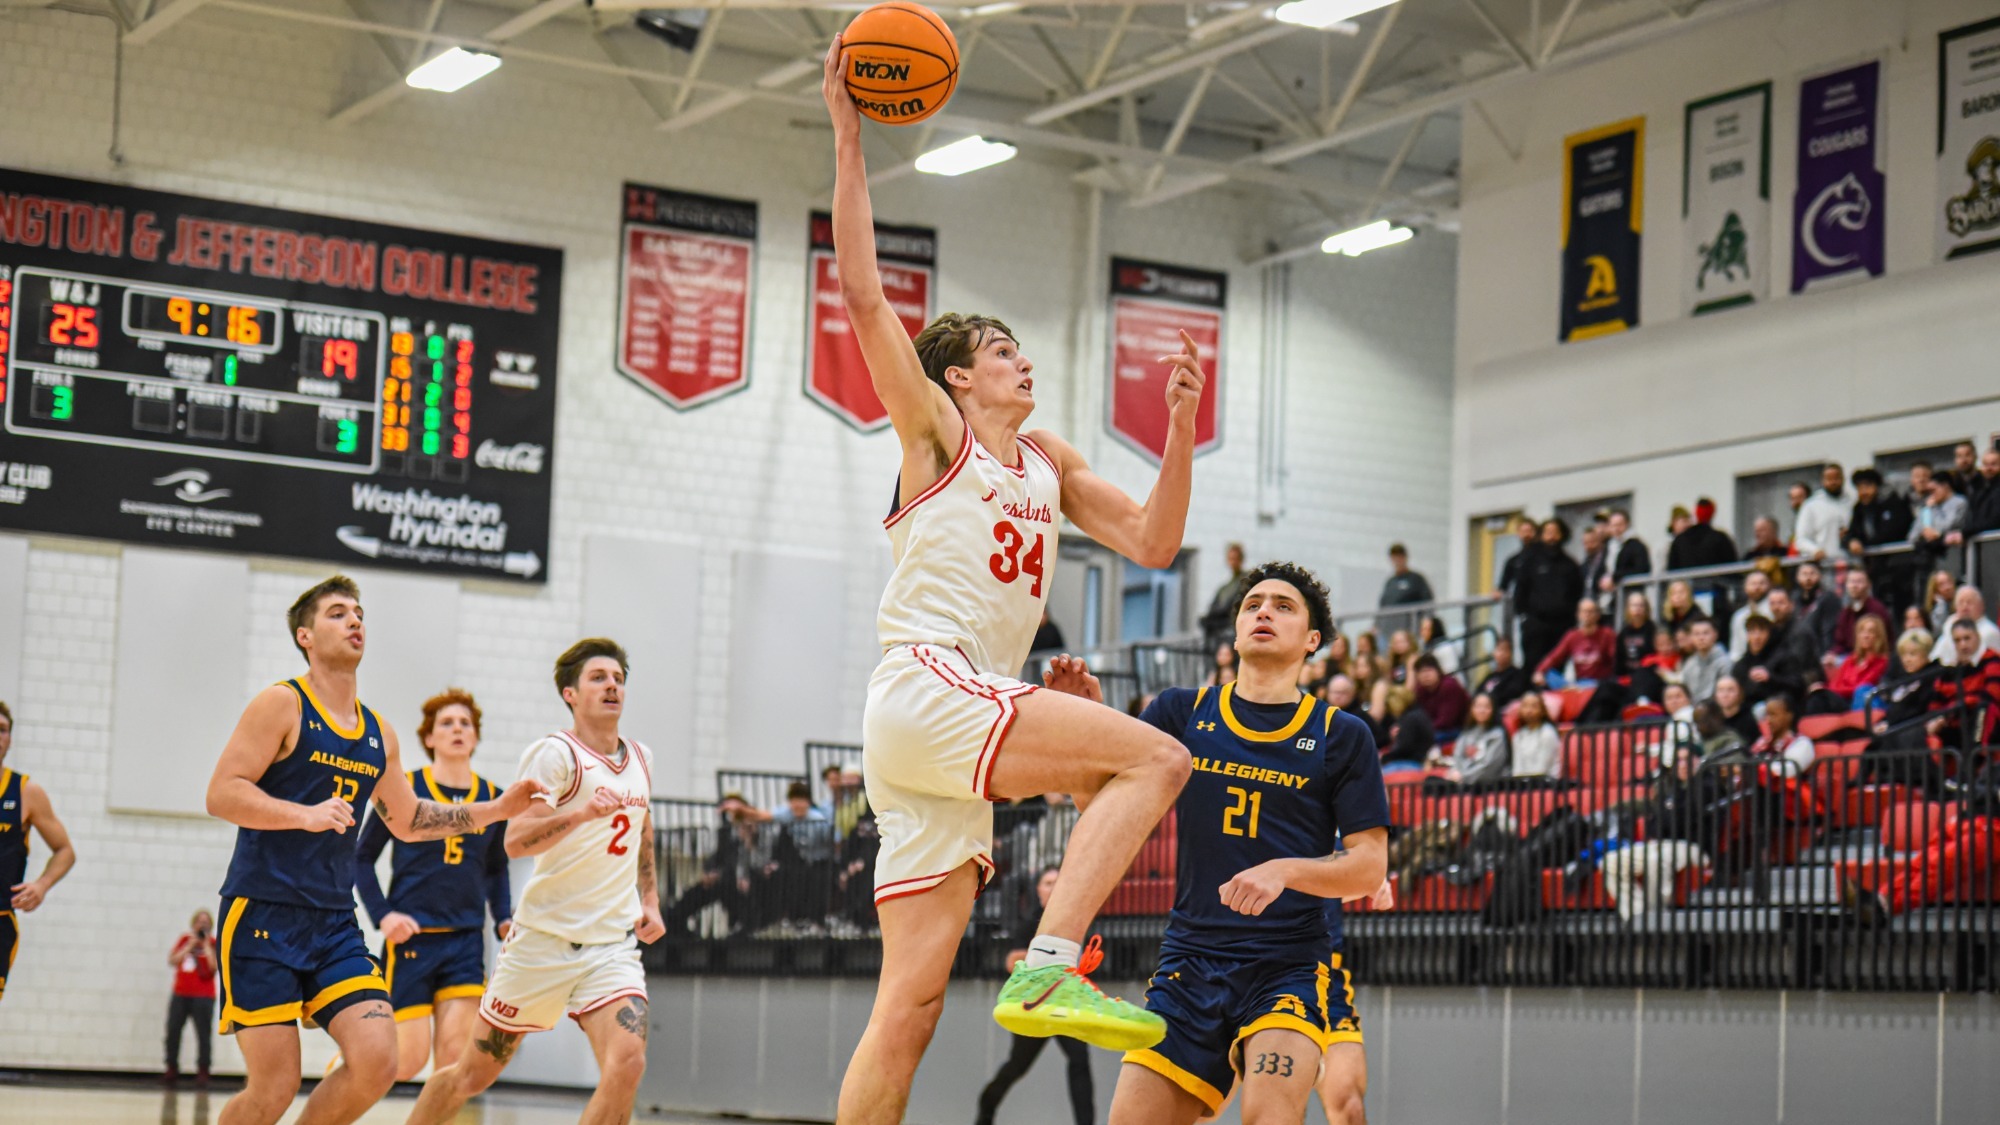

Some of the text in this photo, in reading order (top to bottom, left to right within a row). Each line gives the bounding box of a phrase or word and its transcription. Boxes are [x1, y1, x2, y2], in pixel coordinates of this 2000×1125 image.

[855, 61, 910, 81] NCAA
[130, 211, 165, 261] &
[168, 214, 376, 292] JEFFERSON
[381, 245, 540, 314] COLLEGE
[49, 302, 100, 348] 25
[167, 296, 262, 345] 9:16
[293, 311, 369, 341] VISITOR
[225, 354, 237, 386] 1
[322, 338, 358, 380] 19
[432, 360, 443, 382] 1
[51, 385, 73, 419] 3
[126, 381, 175, 400] PLAYER
[186, 388, 233, 407] POINTS
[336, 418, 358, 453] 3
[452, 433, 469, 459] 3
[8, 462, 52, 490] CLUB
[352, 482, 502, 525] Washington
[176, 519, 235, 538] CENTER
[389, 513, 508, 552] Hyundai
[989, 520, 1044, 599] 34
[1296, 738, 1316, 751] GB
[309, 751, 380, 778] ALLEGHENY
[1191, 757, 1310, 789] ALLEGHENY
[1222, 786, 1262, 838] 21
[444, 836, 464, 865] 15
[607, 814, 631, 856] 2
[1253, 1052, 1294, 1078] 333
